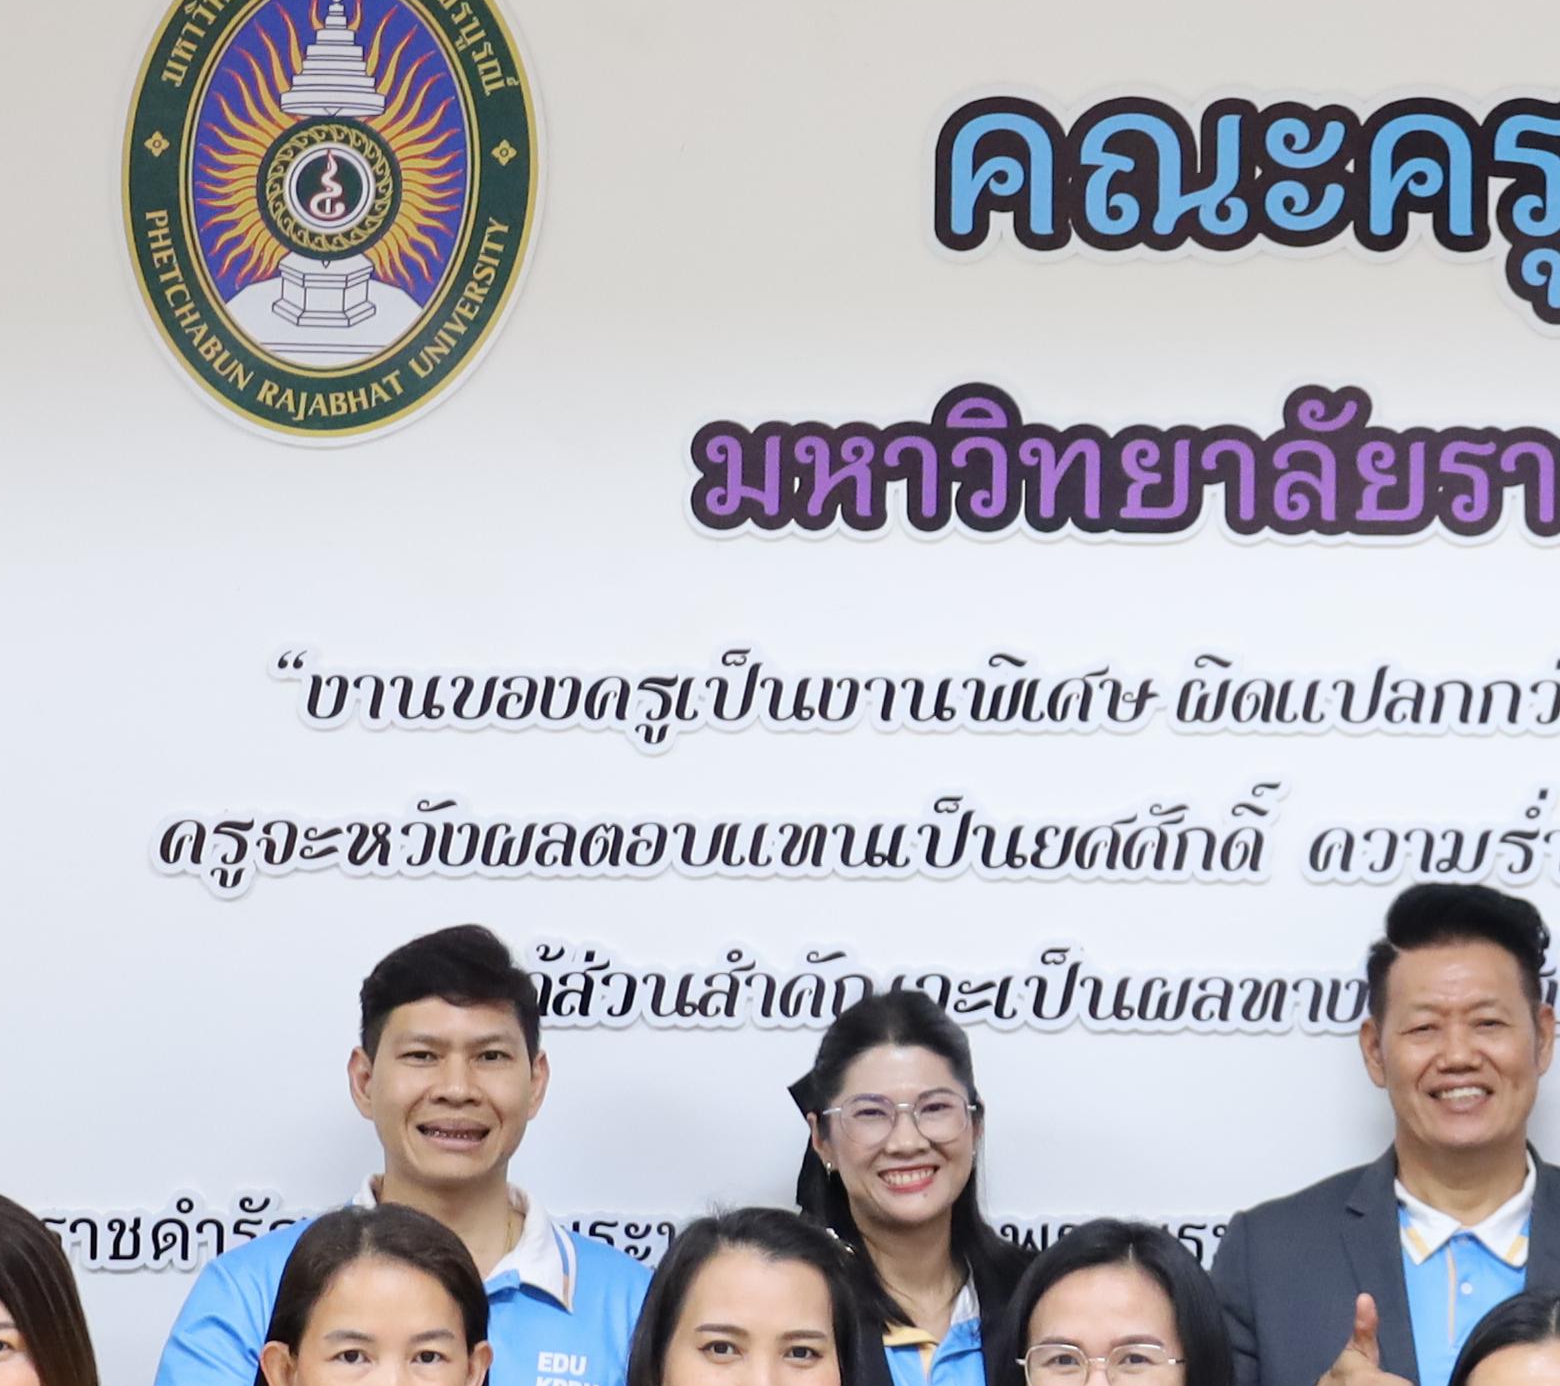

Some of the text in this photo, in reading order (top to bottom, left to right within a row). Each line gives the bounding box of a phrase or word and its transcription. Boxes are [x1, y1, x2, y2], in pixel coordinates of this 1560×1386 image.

[145, 210, 511, 421] PHETCHABUN RAJABHAT UNIVERSITY
[159, 782, 1281, 888] ครูจะหวังผลตอบแทนเป็นยศศักดิ์
[537, 1351, 588, 1375] EDU
